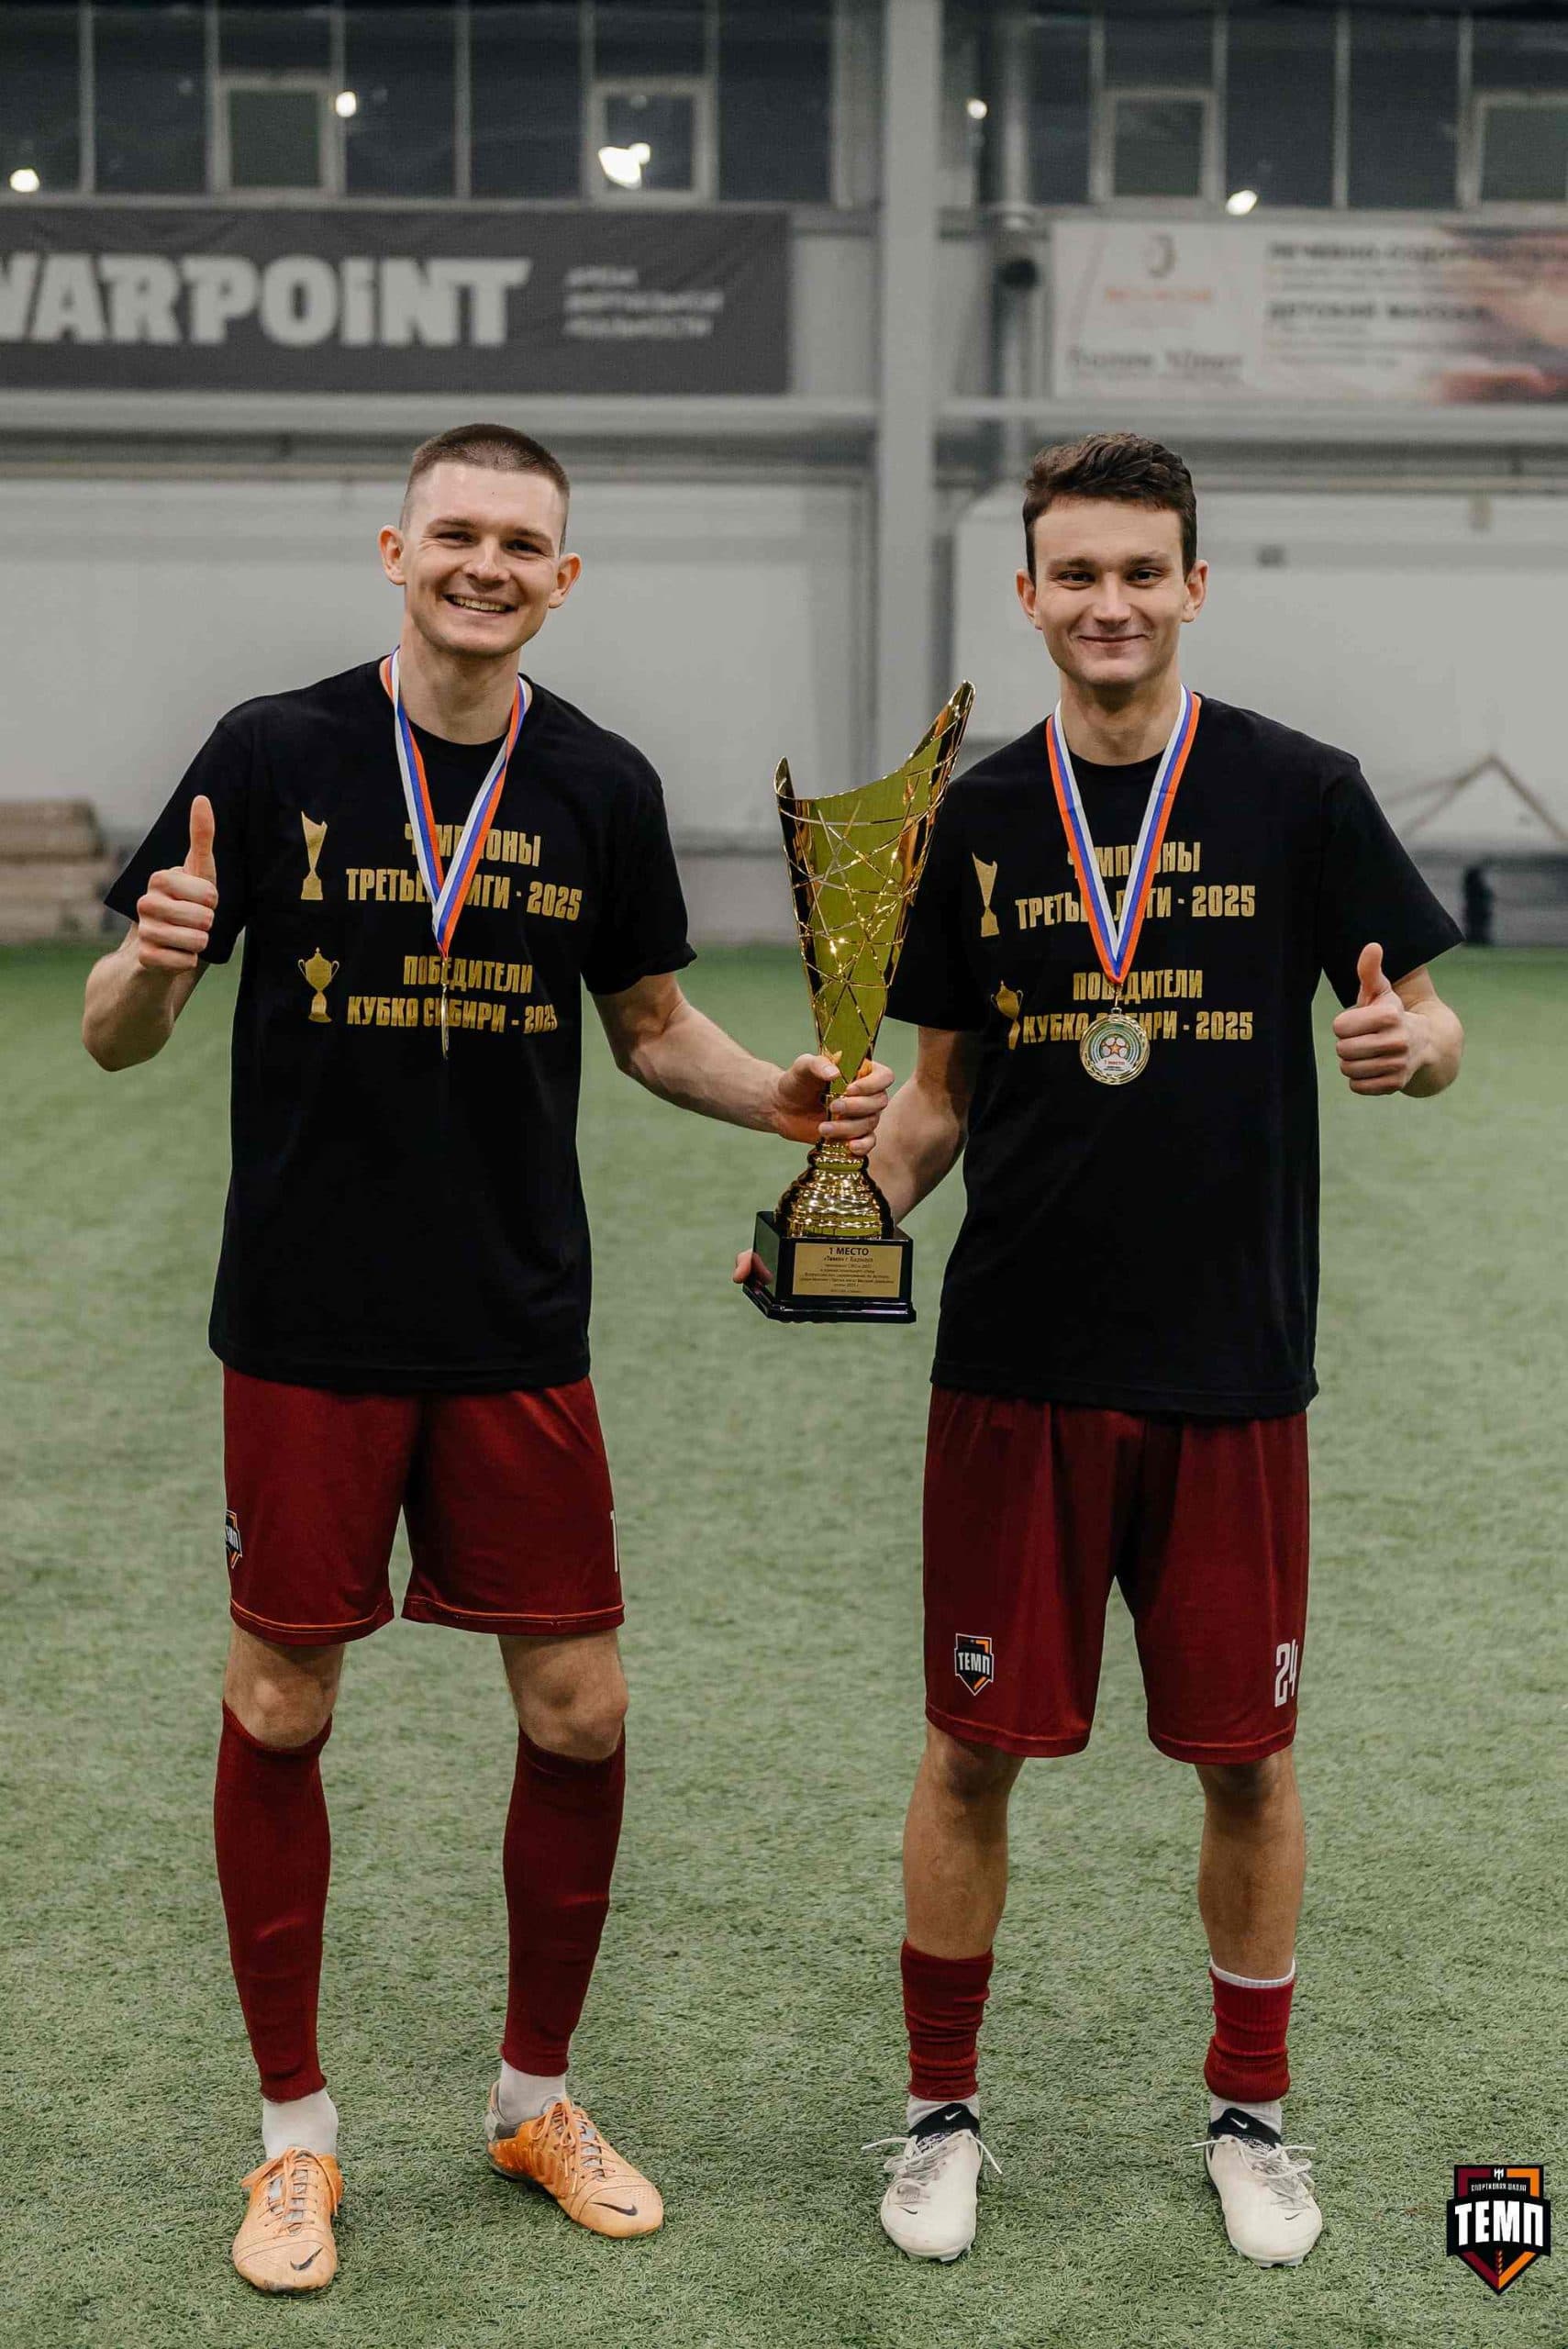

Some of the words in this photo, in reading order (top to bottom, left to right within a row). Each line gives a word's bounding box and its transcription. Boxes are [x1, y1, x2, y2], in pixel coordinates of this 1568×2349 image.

[346, 868, 433, 903] ТРЕТЬЕ
[464, 874, 511, 910] ИГИ
[527, 881, 583, 921] 2025
[1015, 891, 1090, 930] ТРЕТЬ
[1114, 886, 1172, 922] ЛГИ
[1192, 885, 1256, 918] 2025
[1073, 969, 1204, 1005] ПОБДИТЕЛИ
[347, 996, 419, 1028] КУБКА
[523, 1004, 558, 1034] 2025
[1195, 1011, 1254, 1041] 2025
[828, 1246, 834, 1255] 1
[836, 1247, 870, 1255] МЕСТО
[957, 1652, 991, 1675] ТЕМП
